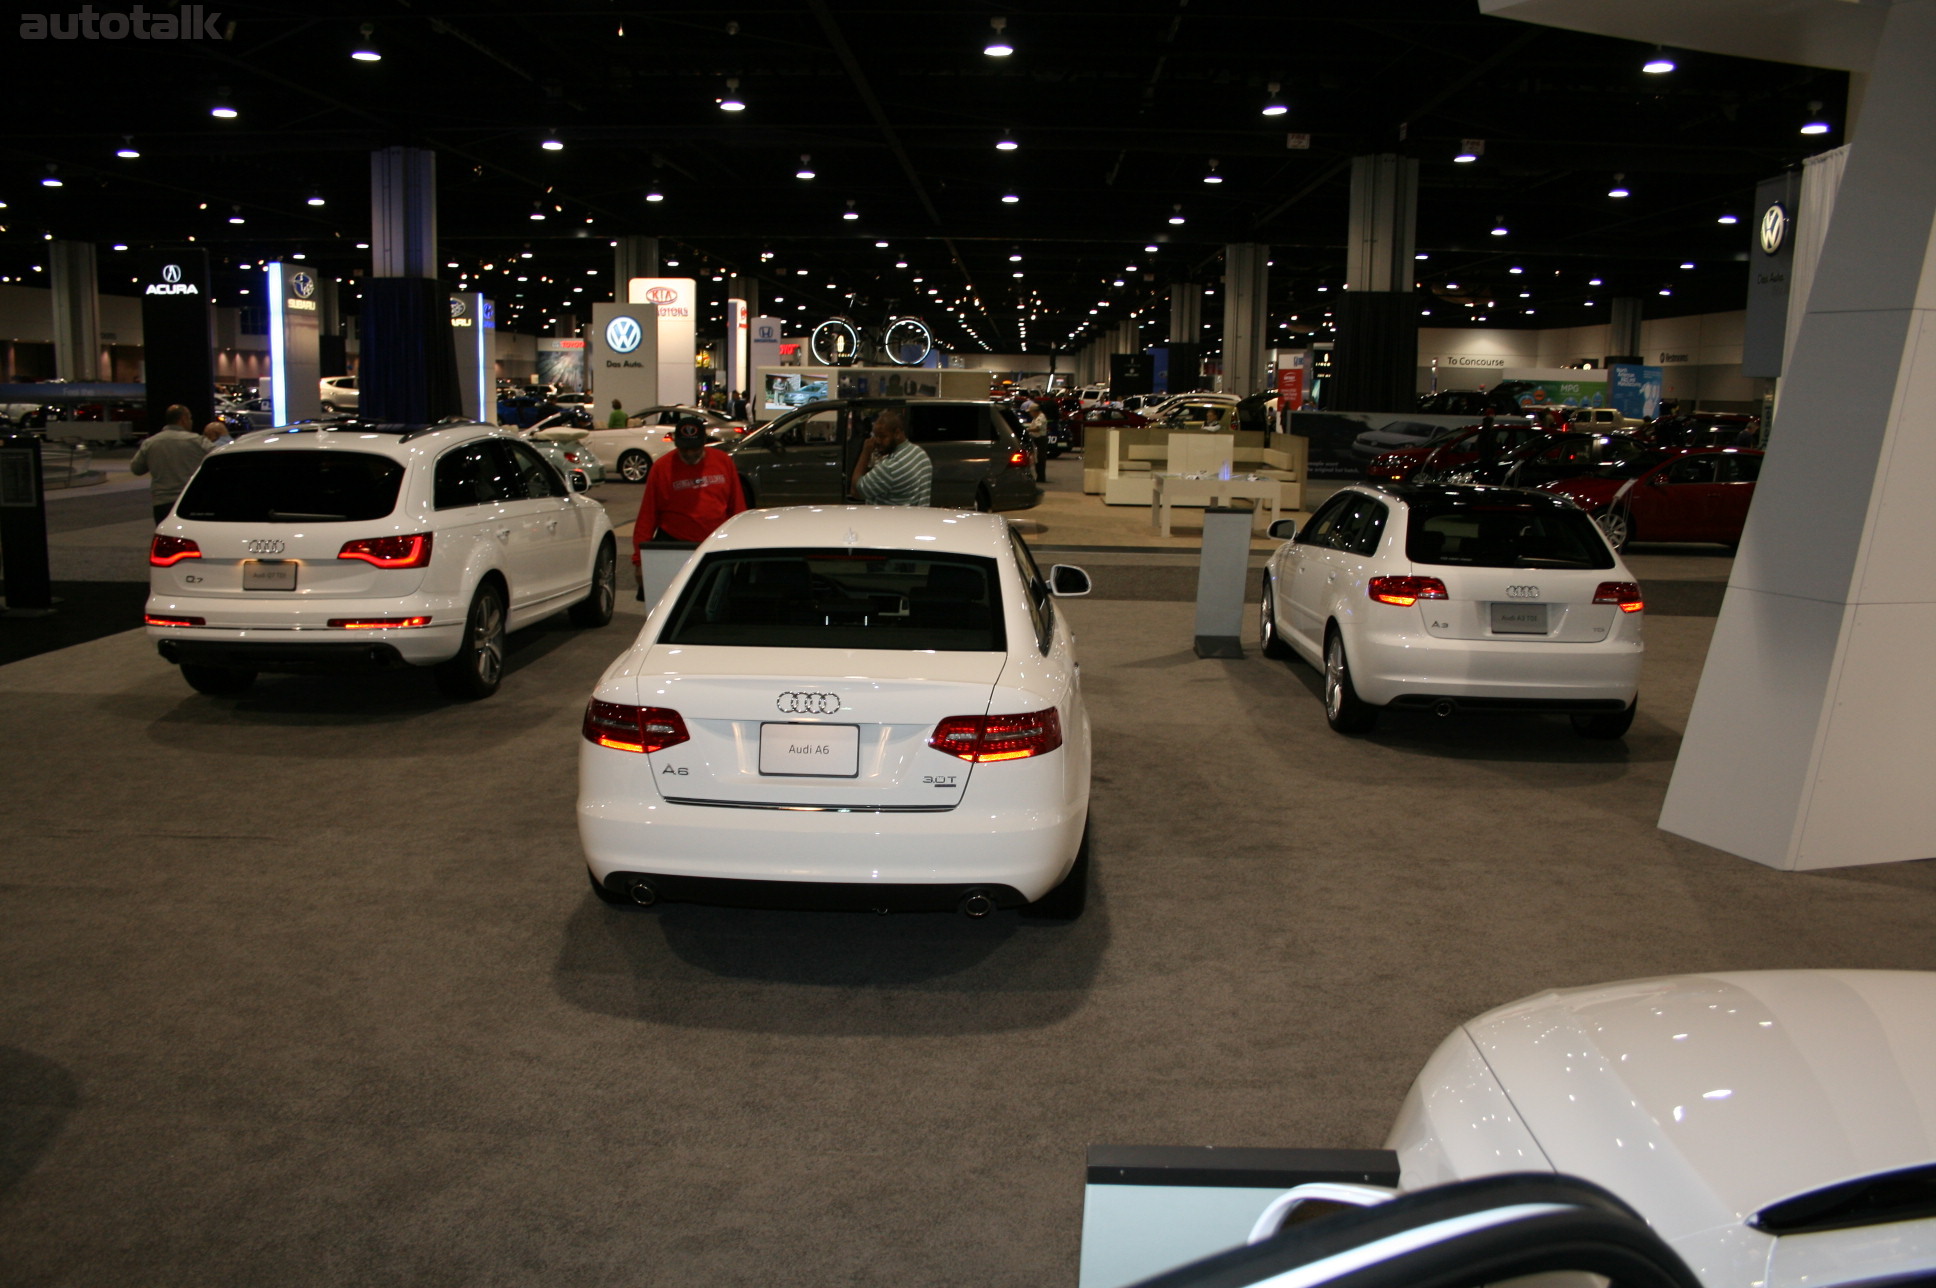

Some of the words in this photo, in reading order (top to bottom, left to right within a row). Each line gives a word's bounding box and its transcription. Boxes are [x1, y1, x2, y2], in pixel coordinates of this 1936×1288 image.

[145, 284, 198, 295] ACURA
[652, 290, 672, 302] KIA
[287, 298, 316, 310] SUBARU
[657, 307, 689, 317] OTORS
[606, 360, 621, 368] Das
[623, 360, 644, 368] Auto.
[1447, 356, 1458, 365] To
[1459, 357, 1504, 366] Concourse
[1560, 384, 1580, 393] MPG
[185, 575, 204, 583] Q7
[1431, 620, 1449, 628] A3
[788, 744, 812, 754] Audi
[815, 745, 830, 755] A6
[662, 763, 689, 776] A6
[922, 775, 957, 784] 3.0T
